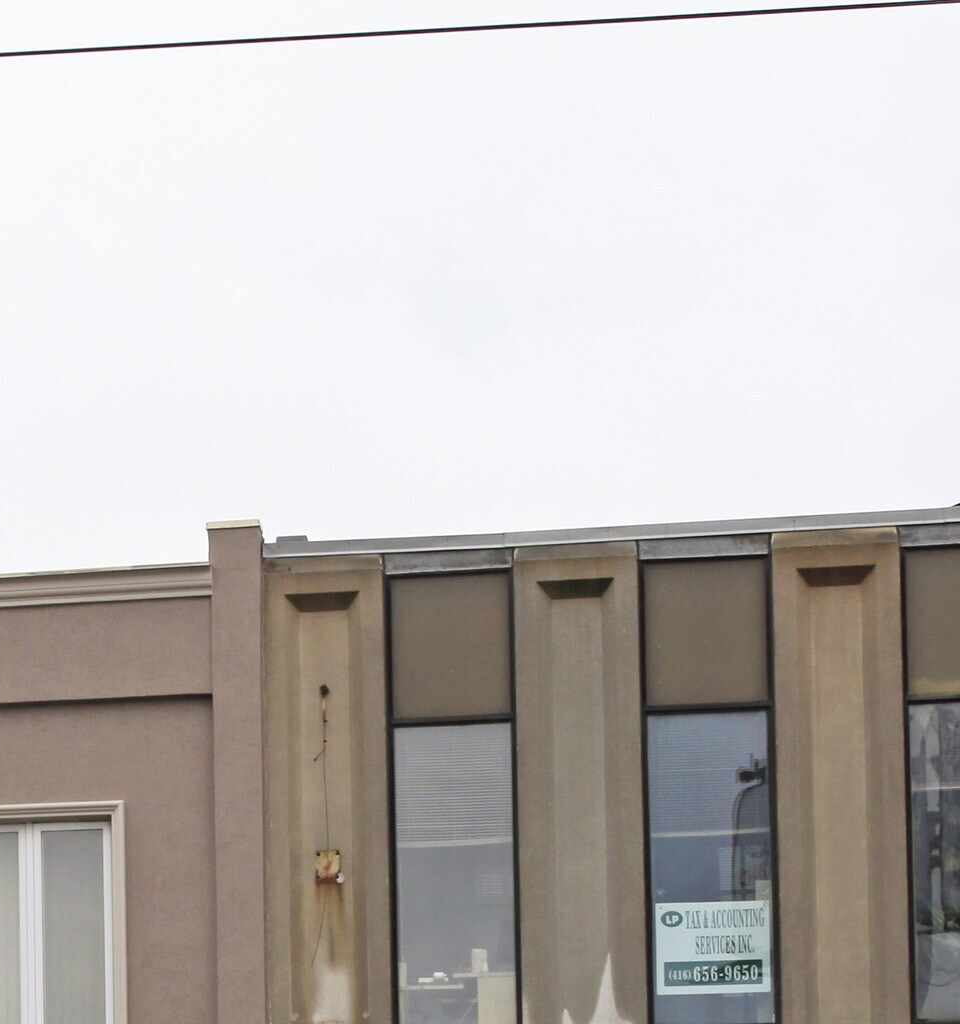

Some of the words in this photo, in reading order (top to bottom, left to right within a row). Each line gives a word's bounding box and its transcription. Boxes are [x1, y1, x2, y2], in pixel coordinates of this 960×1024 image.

[686, 910, 701, 929] TAX
[703, 910, 709, 928] &
[710, 907, 765, 928] ACCOUNTING
[695, 935, 736, 955] SERVICES
[738, 934, 755, 954] INC.
[668, 969, 692, 981] (416)
[693, 964, 759, 983] 656-9650
